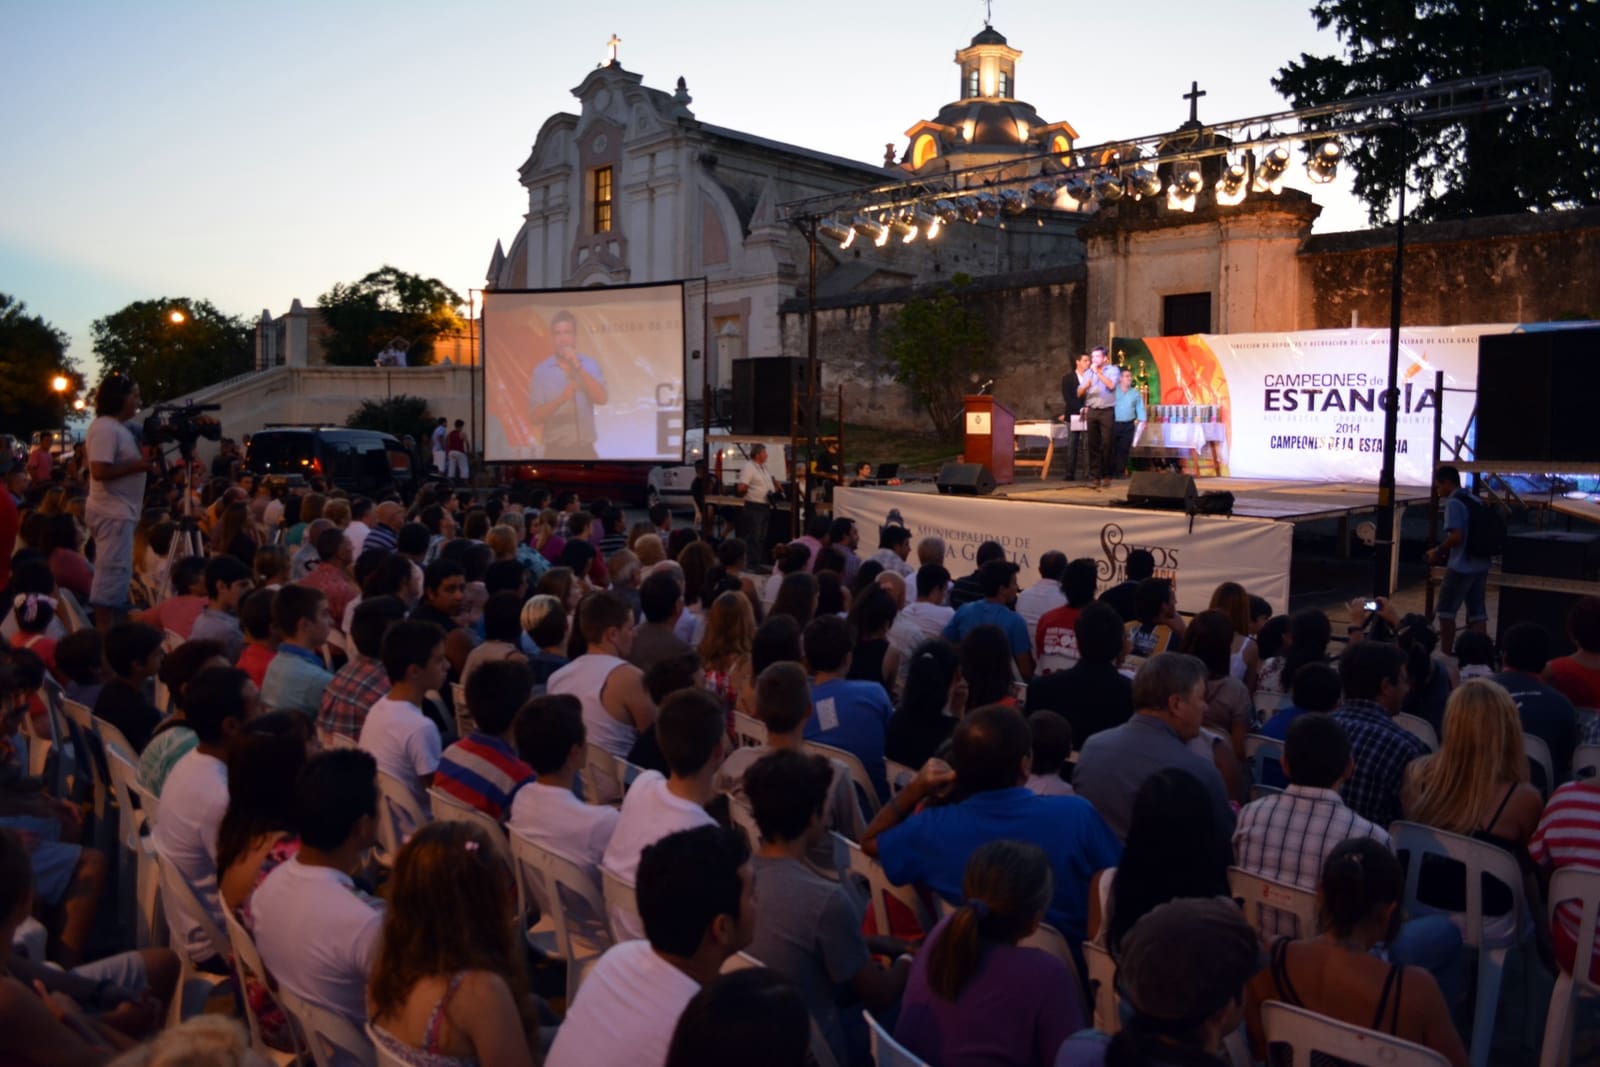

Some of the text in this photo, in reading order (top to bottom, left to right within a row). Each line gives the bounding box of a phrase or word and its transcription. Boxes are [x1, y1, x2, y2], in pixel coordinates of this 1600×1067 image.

[1438, 337, 1454, 345] ALTA
[1456, 336, 1478, 345] GRACI
[1264, 373, 1384, 388] CAMPEONES de
[1335, 423, 1361, 434] 2014
[1358, 438, 1409, 454] ESTAIA
[917, 525, 1031, 549] MUNICIPALIDAD DE
